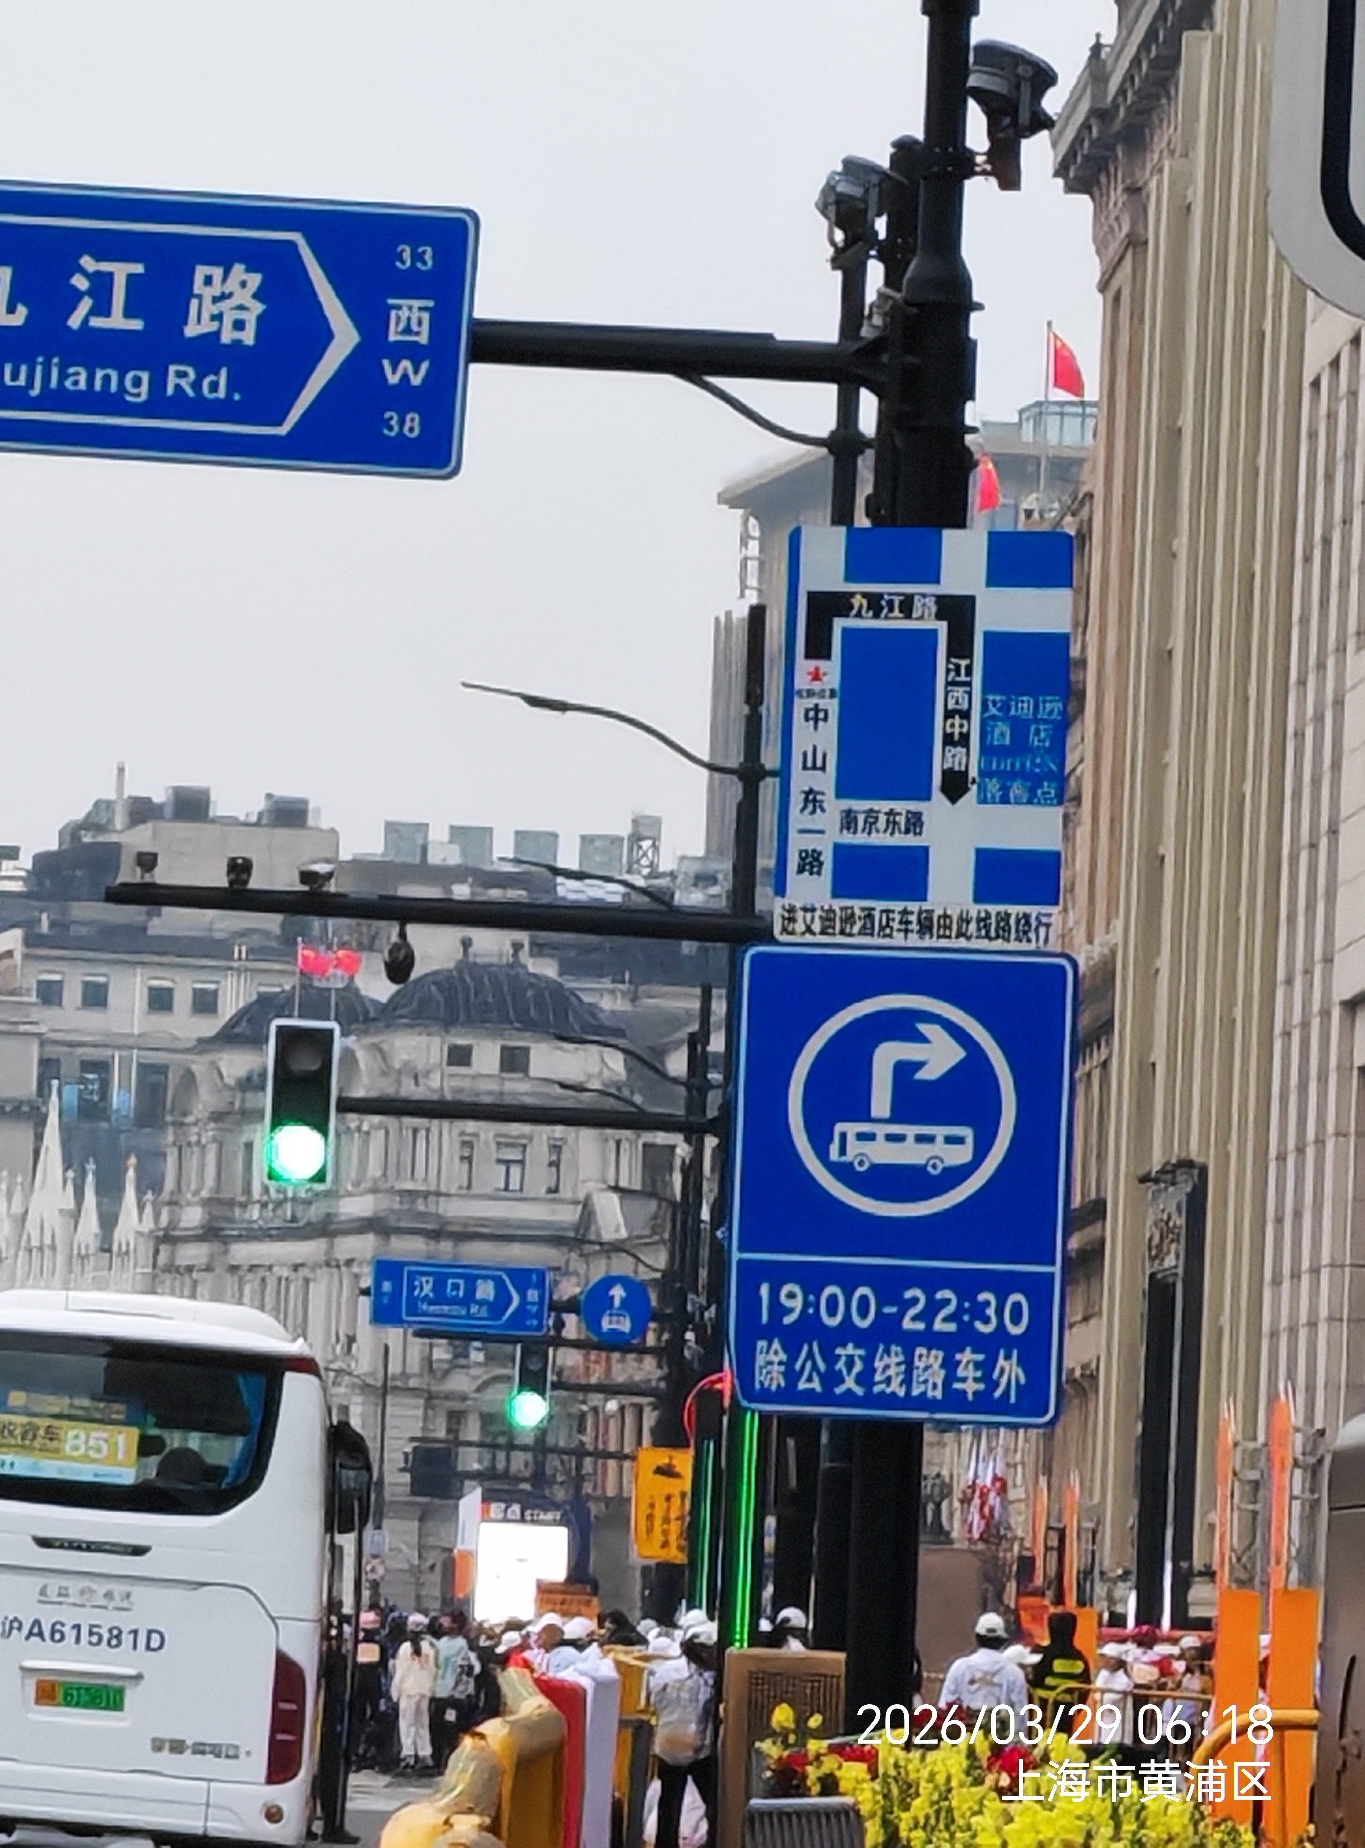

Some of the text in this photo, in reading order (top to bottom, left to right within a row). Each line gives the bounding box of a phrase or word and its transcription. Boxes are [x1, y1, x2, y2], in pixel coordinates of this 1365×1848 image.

[395, 244, 434, 271] 33
[387, 298, 435, 346] 西
[165, 364, 242, 401] Rd.
[382, 359, 430, 387] W
[383, 411, 421, 438] 38
[848, 593, 938, 620] 九江路
[945, 657, 971, 772] 江西中路
[795, 703, 829, 877] 中山东一路
[839, 808, 925, 838] 南京东路
[758, 1282, 1030, 1336] 19:00-22:30
[755, 1338, 1026, 1404] 除公交线路车外
[64, 1428, 128, 1461] 851
[0, 1615, 166, 1653] 沪A61581D
